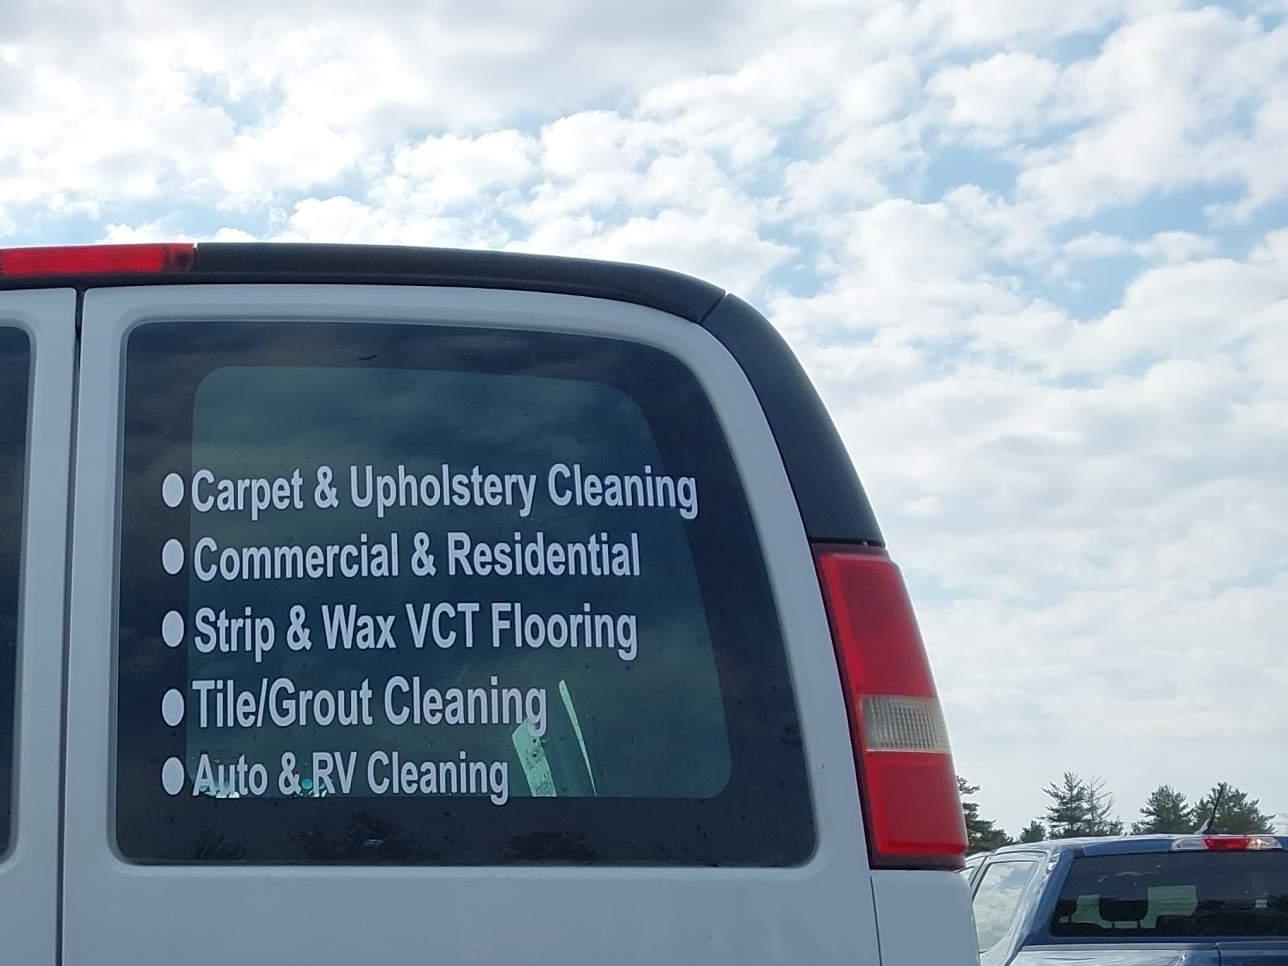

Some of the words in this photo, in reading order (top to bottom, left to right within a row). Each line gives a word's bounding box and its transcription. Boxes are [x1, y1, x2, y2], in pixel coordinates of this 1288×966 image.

[192, 467, 304, 521] Carpet
[314, 466, 338, 510] &
[350, 464, 536, 518] Upholstery
[548, 463, 698, 519] Cleaning
[194, 534, 399, 582] Commercial
[412, 533, 436, 577] &
[448, 531, 641, 577] Residential
[194, 605, 274, 662] Strip
[286, 605, 312, 651] &
[322, 604, 395, 649] Wax
[406, 603, 479, 648] VCT
[492, 602, 638, 661] Flooring
[192, 679, 373, 729] Tile/Grout
[384, 676, 547, 736] Cleaning
[192, 754, 268, 796] Auto
[278, 753, 302, 796] &
[313, 752, 357, 795] RV
[367, 751, 509, 805] Cleaning
